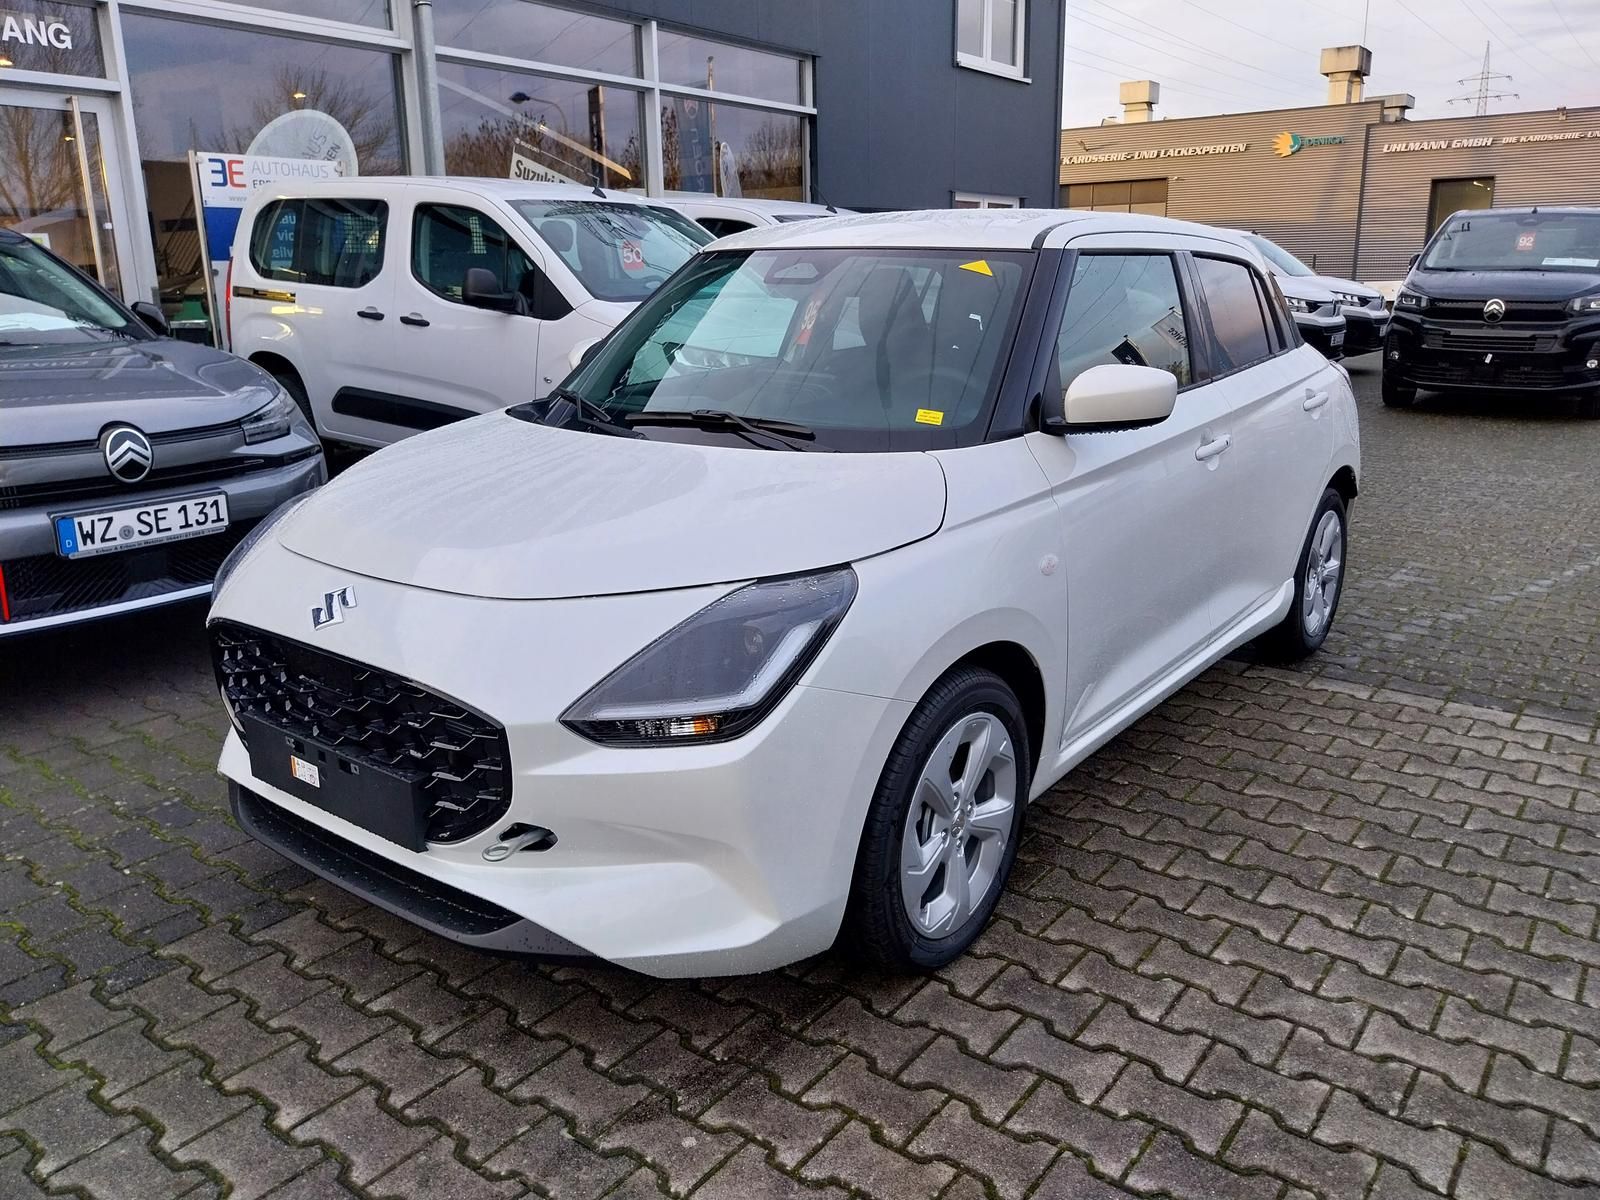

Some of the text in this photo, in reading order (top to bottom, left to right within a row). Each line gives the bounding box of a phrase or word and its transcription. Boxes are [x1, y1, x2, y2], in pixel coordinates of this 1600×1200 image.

[2, 16, 72, 50] ANG
[1383, 140, 1448, 153] UHLMANN
[1451, 136, 1493, 148] GMBH
[1502, 135, 1519, 144] DIE
[1520, 131, 1585, 143] KAROSSERIE-
[1062, 143, 1247, 165] KAROSSERIE- UND LACKEXPERTEN
[251, 160, 329, 178] AUTOHAUS
[514, 159, 555, 183] Suzuki
[1519, 236, 1534, 247] 92
[623, 247, 642, 263] 50
[77, 516, 117, 546] WZ
[136, 507, 172, 536] SE
[177, 499, 225, 530] 131
[65, 539, 73, 548] D
